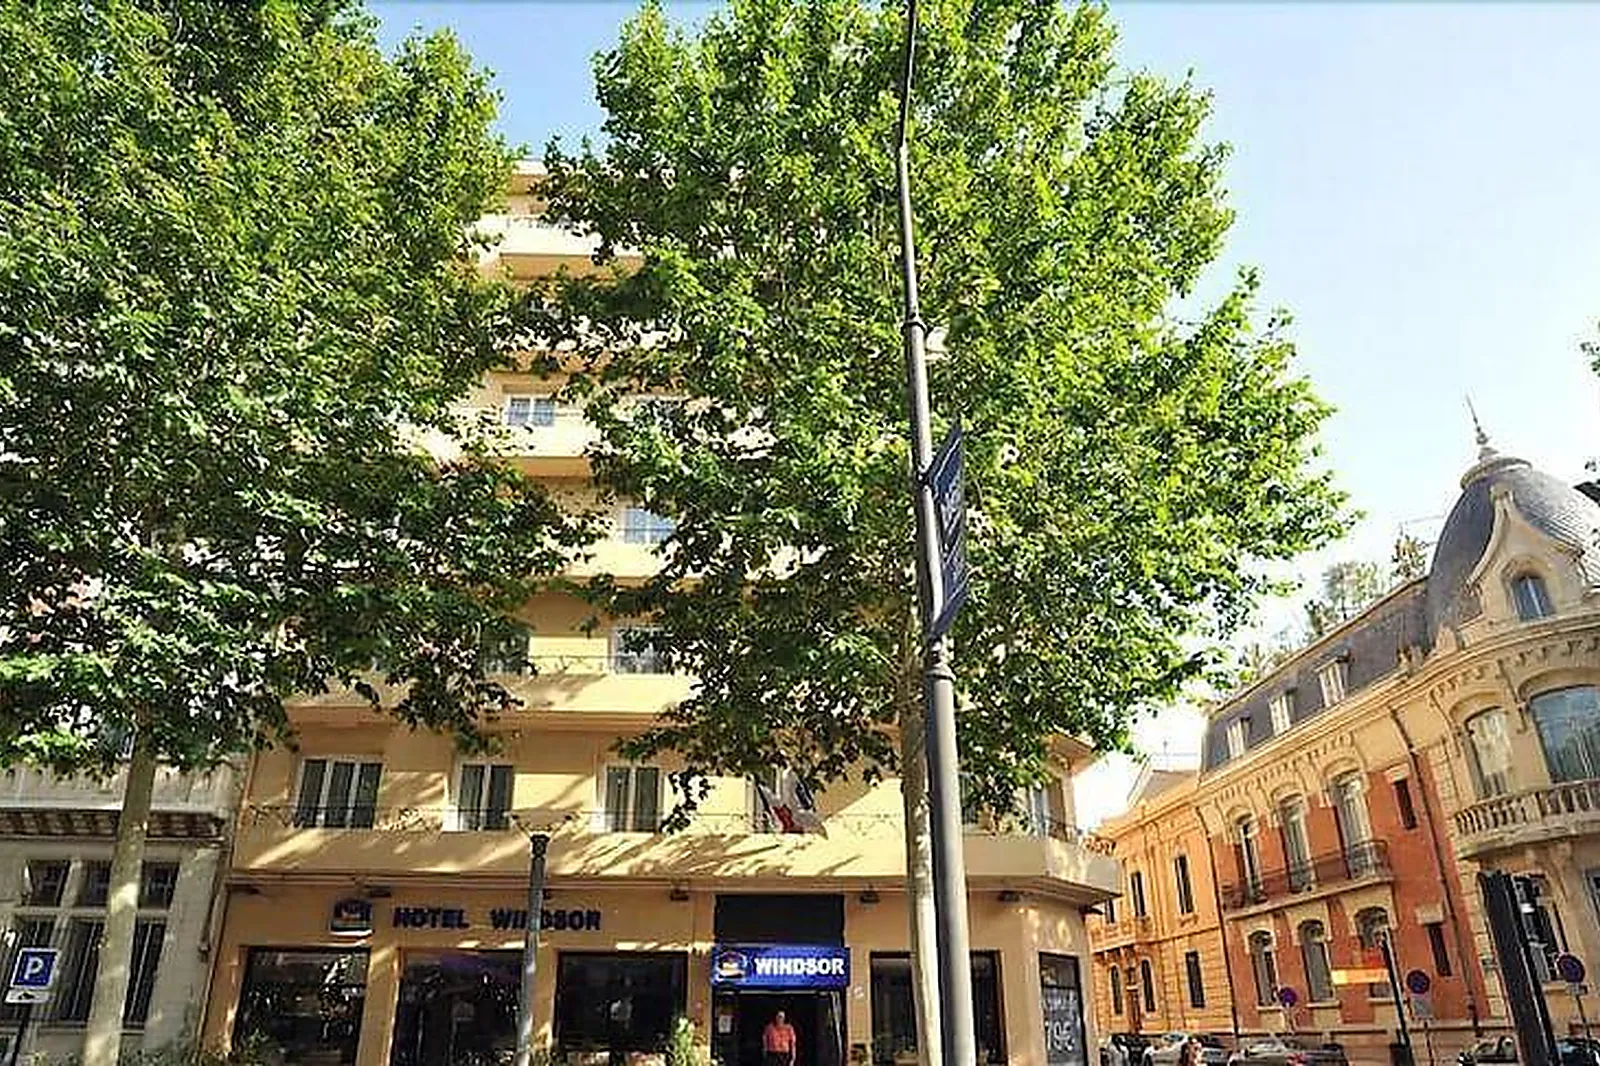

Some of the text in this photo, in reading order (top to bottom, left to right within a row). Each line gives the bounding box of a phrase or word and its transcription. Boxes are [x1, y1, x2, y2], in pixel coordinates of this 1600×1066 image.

[393, 907, 469, 929] HOTEL
[24, 957, 43, 980] P
[754, 958, 845, 975] WINDSOR
